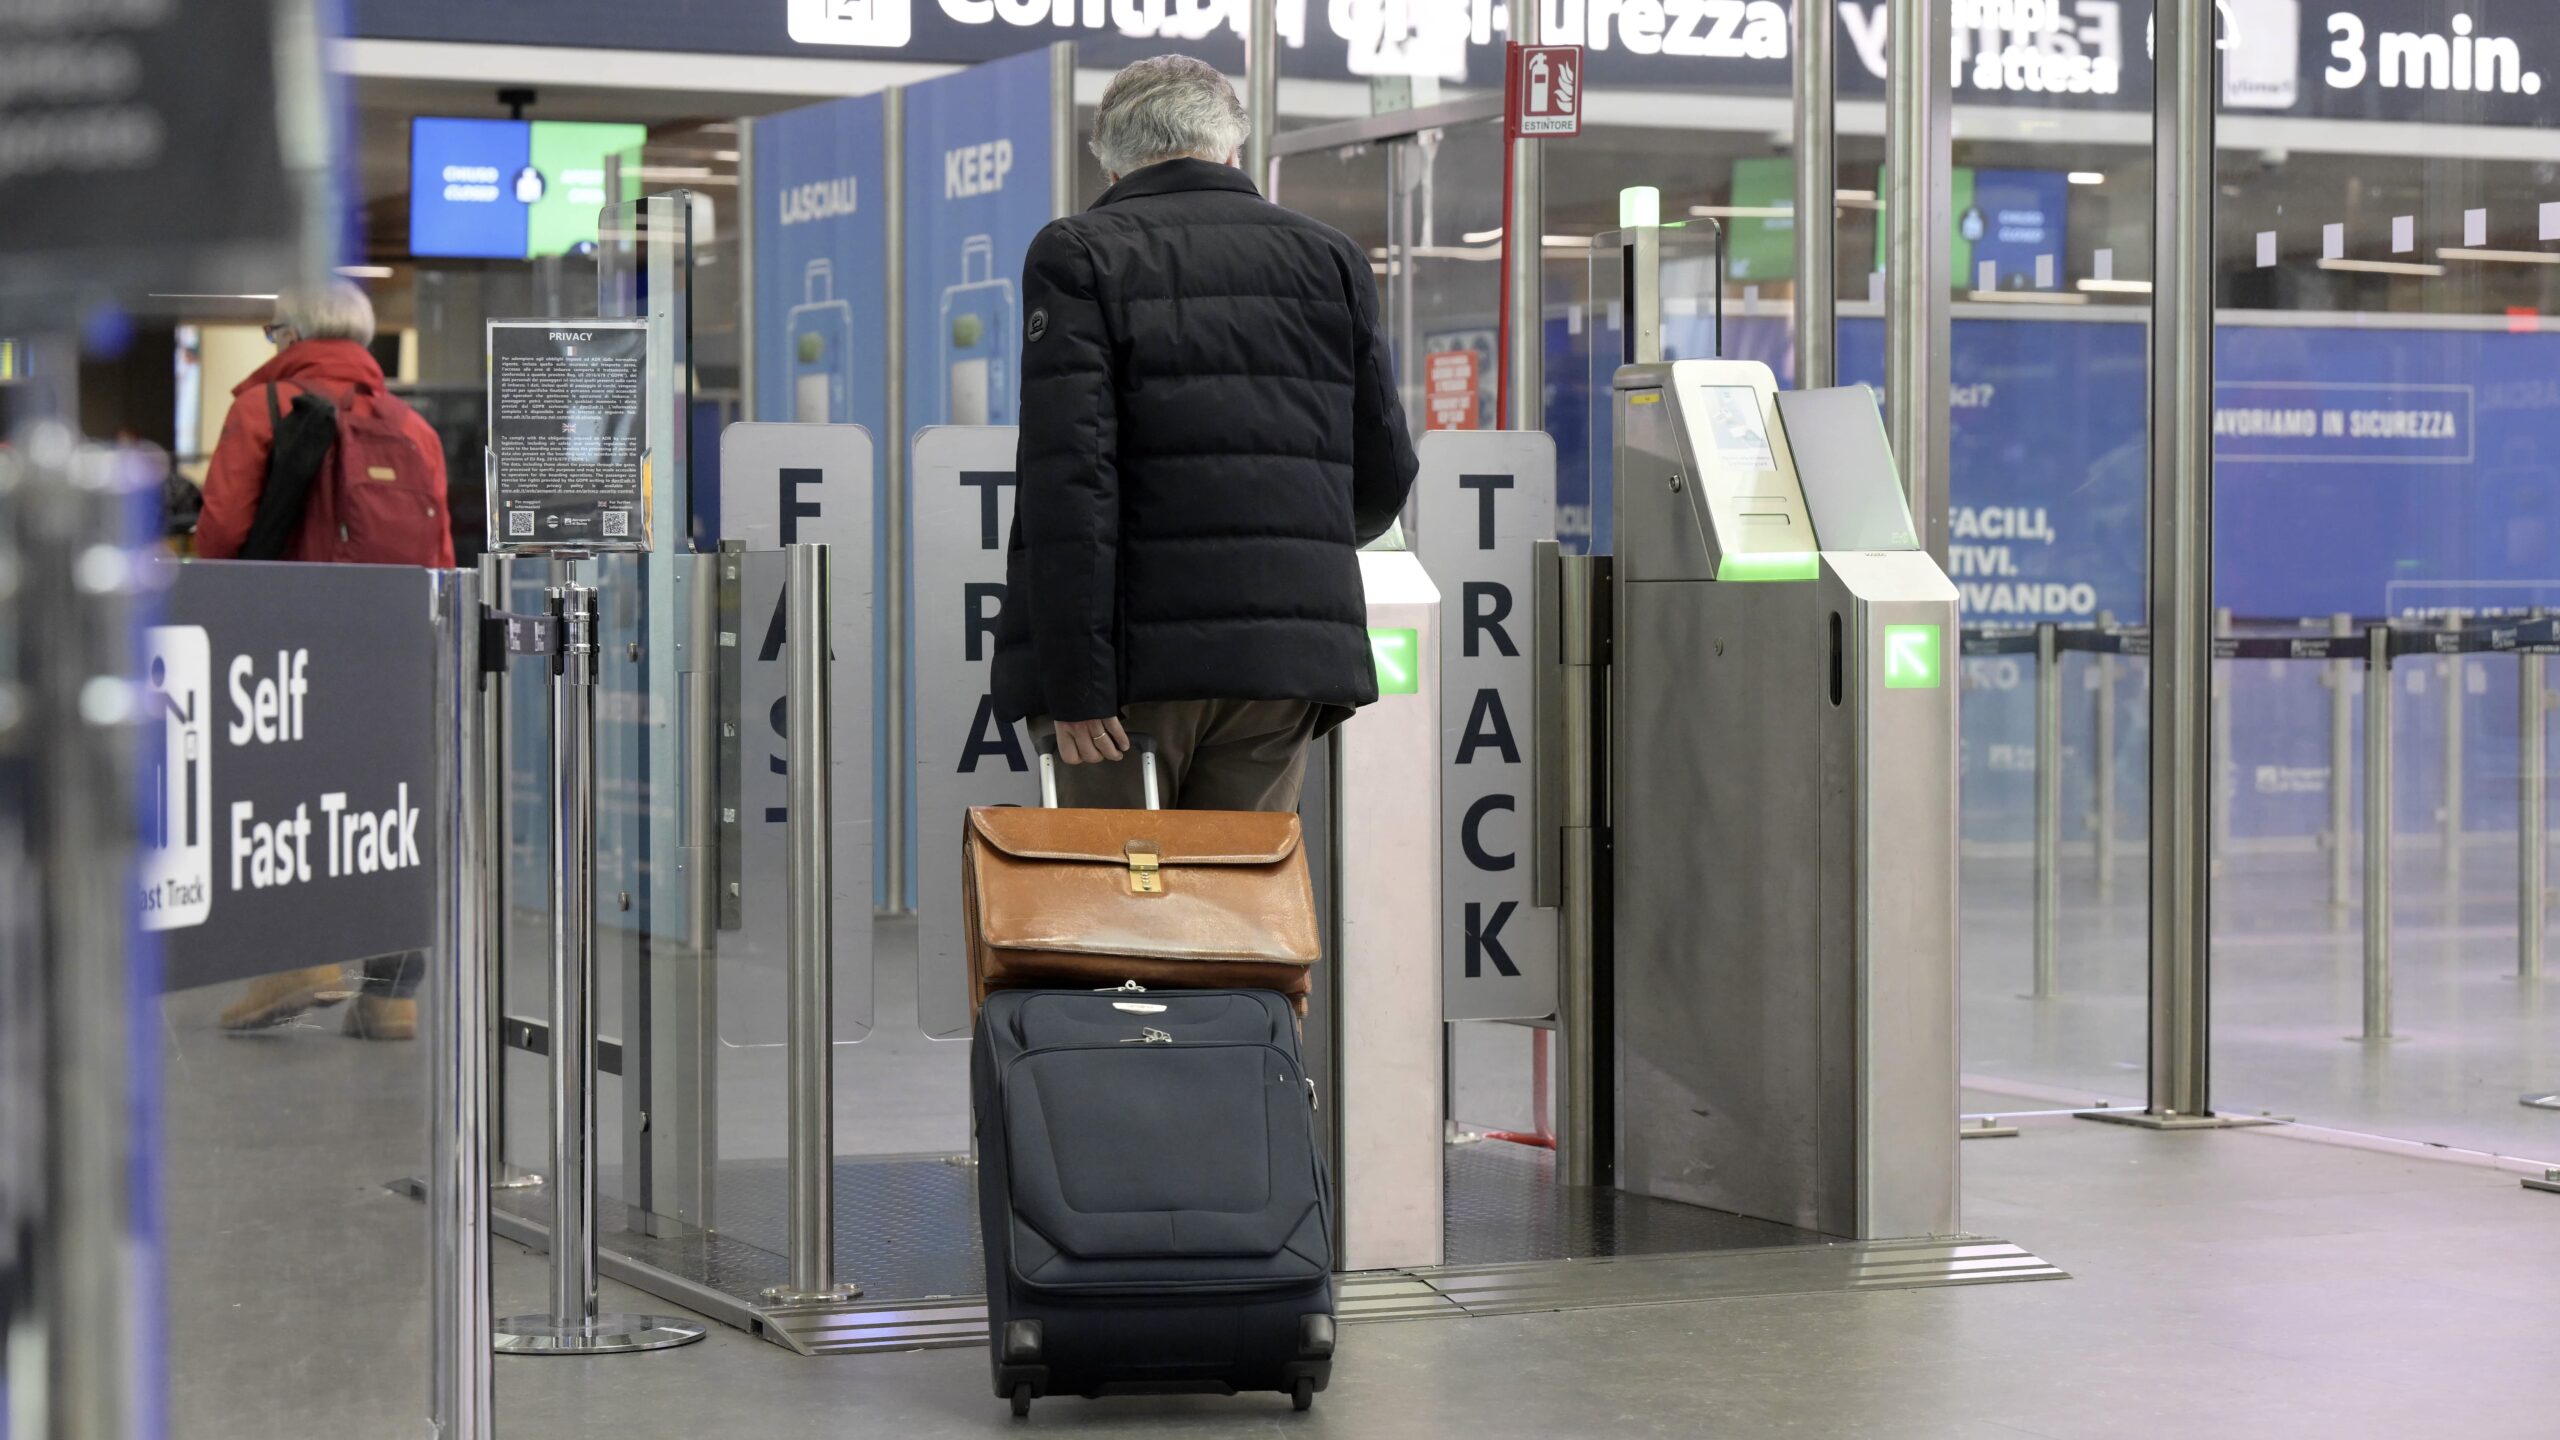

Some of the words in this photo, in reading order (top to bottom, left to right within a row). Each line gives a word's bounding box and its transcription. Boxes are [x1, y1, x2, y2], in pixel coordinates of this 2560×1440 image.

[2325, 12, 2367, 88] 3
[2379, 13, 2541, 95] min.
[1524, 121, 1573, 130] ESTINTORE
[945, 139, 1013, 200] KEEP
[780, 176, 857, 225] LASCIALI
[549, 332, 593, 341] PRIVACY
[2214, 408, 2317, 437] AVORIAMO
[2322, 409, 2344, 437] IN
[2350, 409, 2456, 438] SICUREZZA
[1949, 544, 2018, 577] TIVI.
[1960, 581, 2097, 615] IVANDO
[229, 648, 308, 746] Self
[1455, 474, 1521, 978] TRACK
[231, 800, 311, 891] Fast
[320, 782, 420, 878] Track
[140, 883, 162, 912] ast
[166, 876, 204, 907] Track
